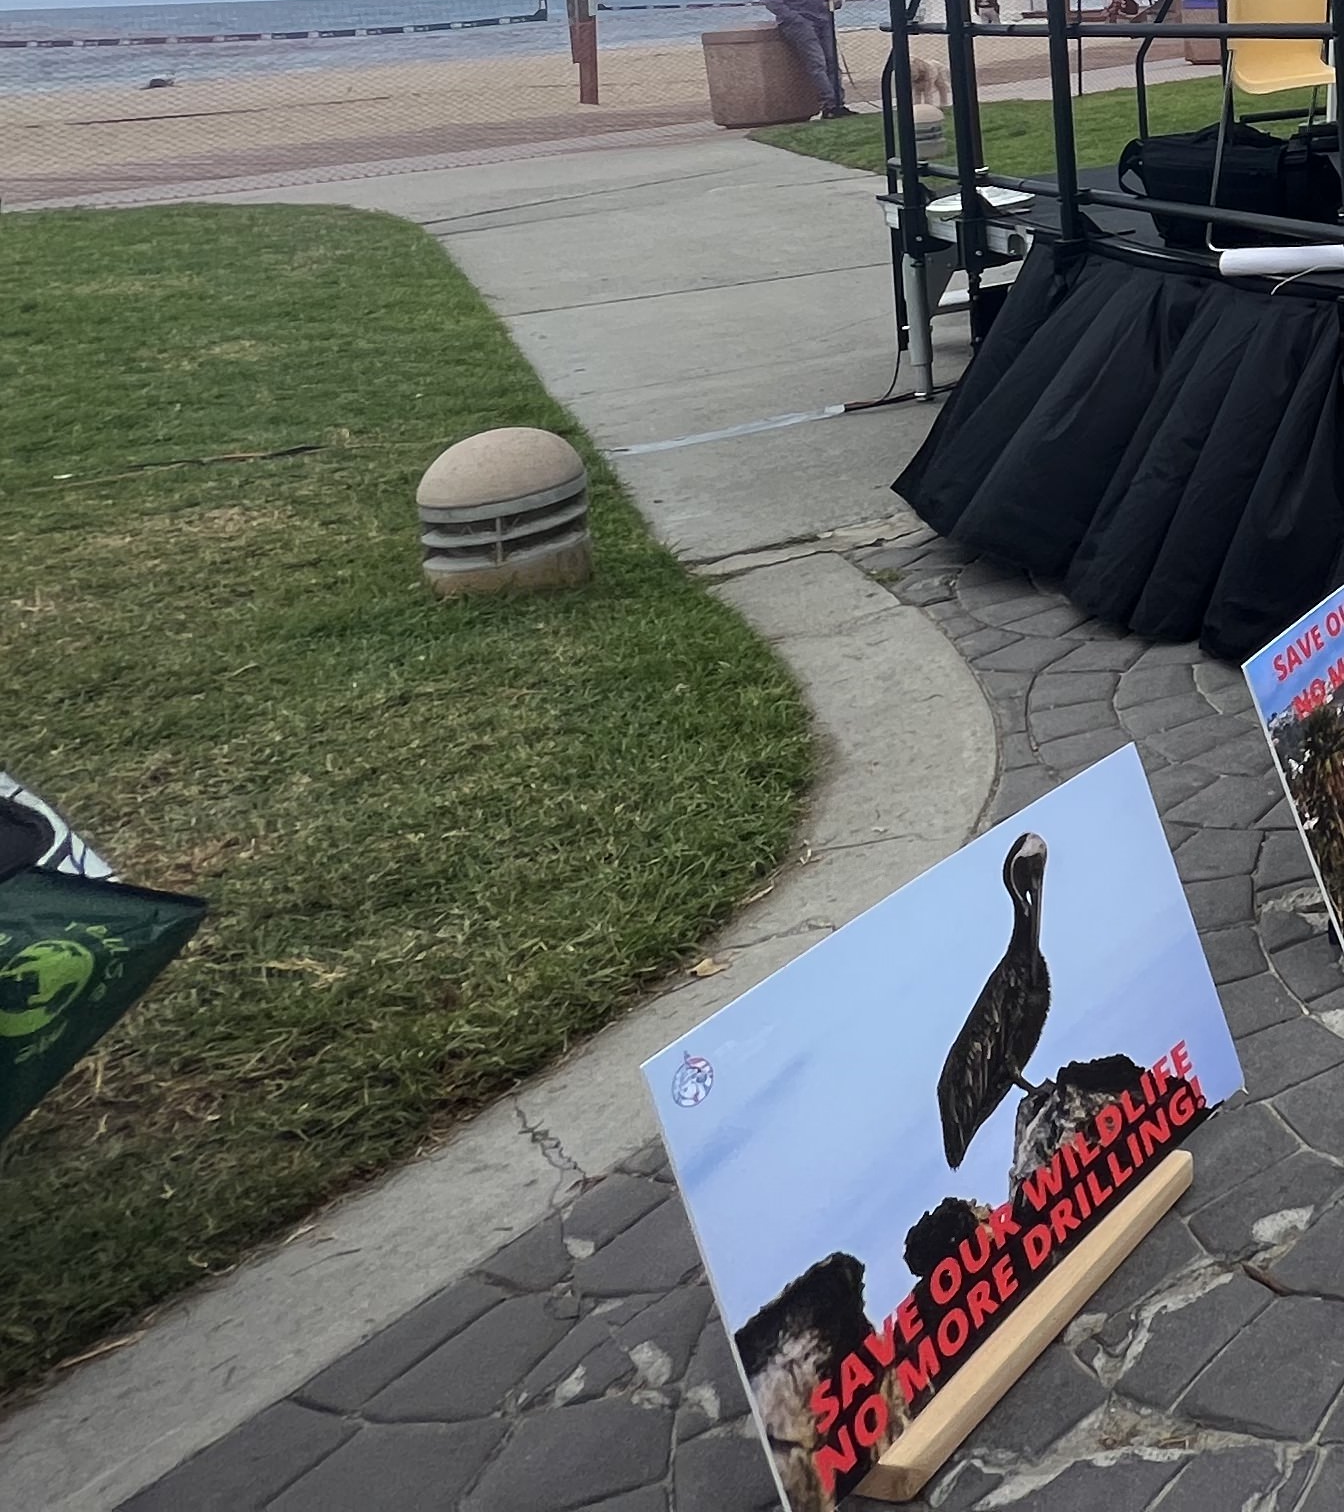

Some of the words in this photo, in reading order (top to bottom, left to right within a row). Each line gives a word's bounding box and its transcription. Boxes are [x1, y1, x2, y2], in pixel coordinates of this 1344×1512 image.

[1273, 624, 1325, 681] SAVE
[1292, 678, 1328, 721] NO
[809, 1292, 925, 1434] SAVE
[929, 1202, 1021, 1305] OUR
[1022, 1039, 1193, 1212] WILDLIFE
[814, 1394, 889, 1496] NO
[898, 1254, 1019, 1406] MORE
[1021, 1075, 1207, 1271] DRILLING!
